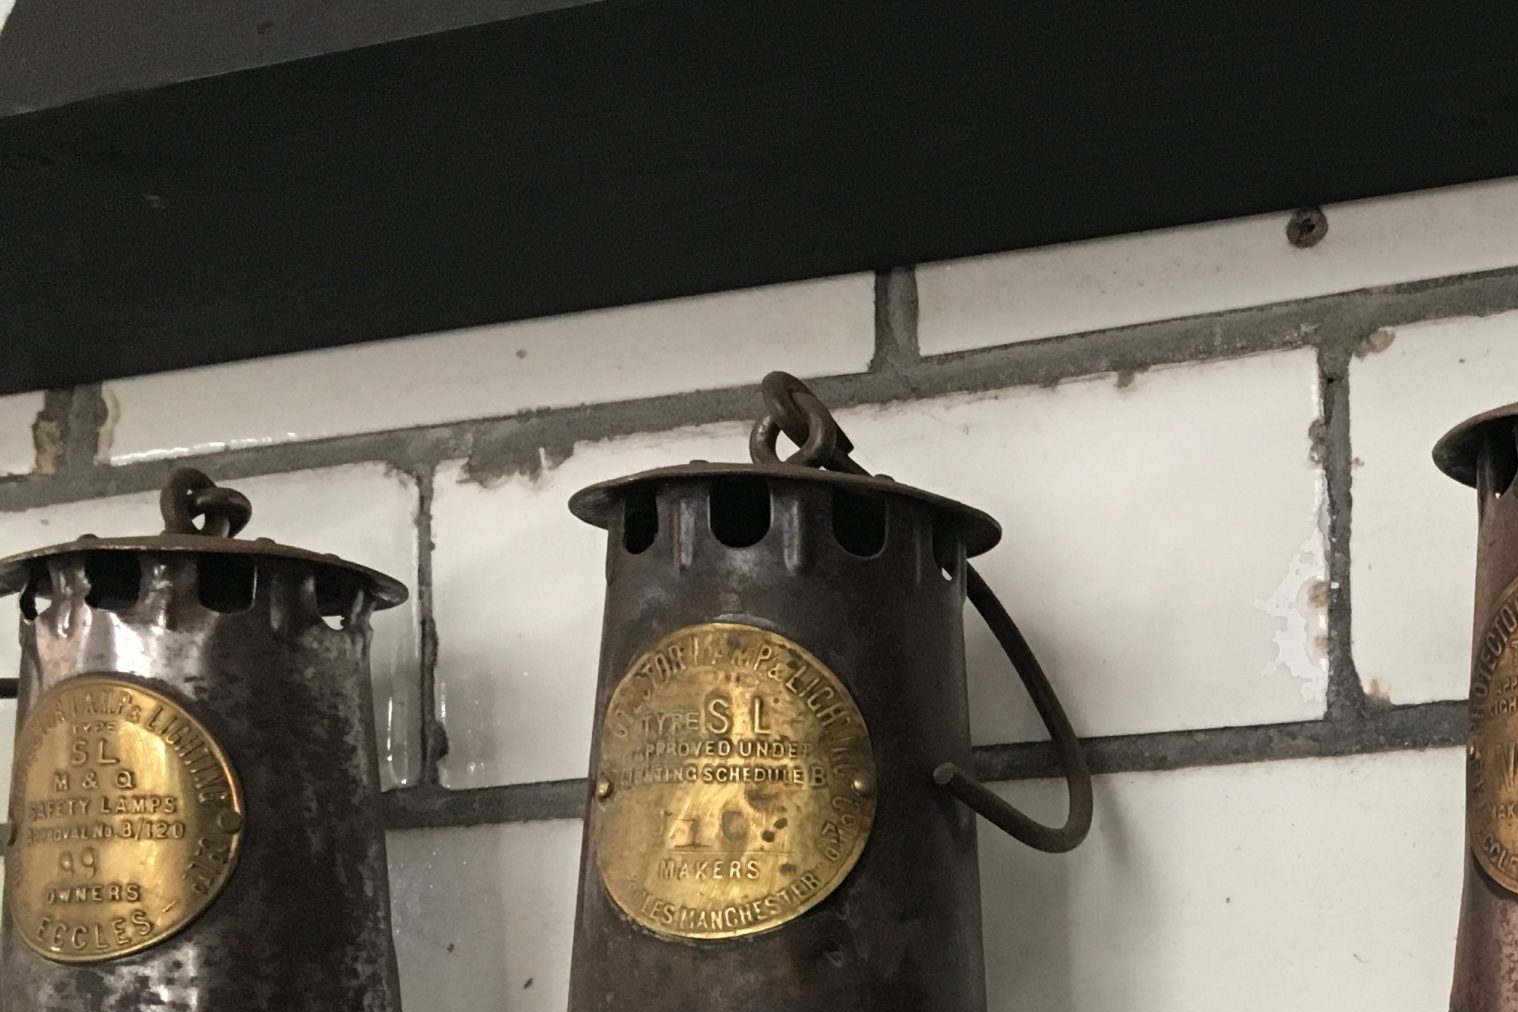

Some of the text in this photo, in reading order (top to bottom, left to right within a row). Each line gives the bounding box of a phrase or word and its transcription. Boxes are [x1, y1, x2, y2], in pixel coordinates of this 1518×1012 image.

[641, 709, 700, 737] TYPE
[739, 739, 813, 758] UNDER
[82, 769, 100, 791] &
[114, 769, 136, 790] Q
[702, 764, 804, 783] SCHEDULE
[811, 766, 827, 787] B
[28, 797, 178, 821] SAFETY LAMPS
[658, 858, 761, 881] MAKERS
[677, 872, 823, 931] MANCHESTER
[37, 909, 154, 951] ECCLES
